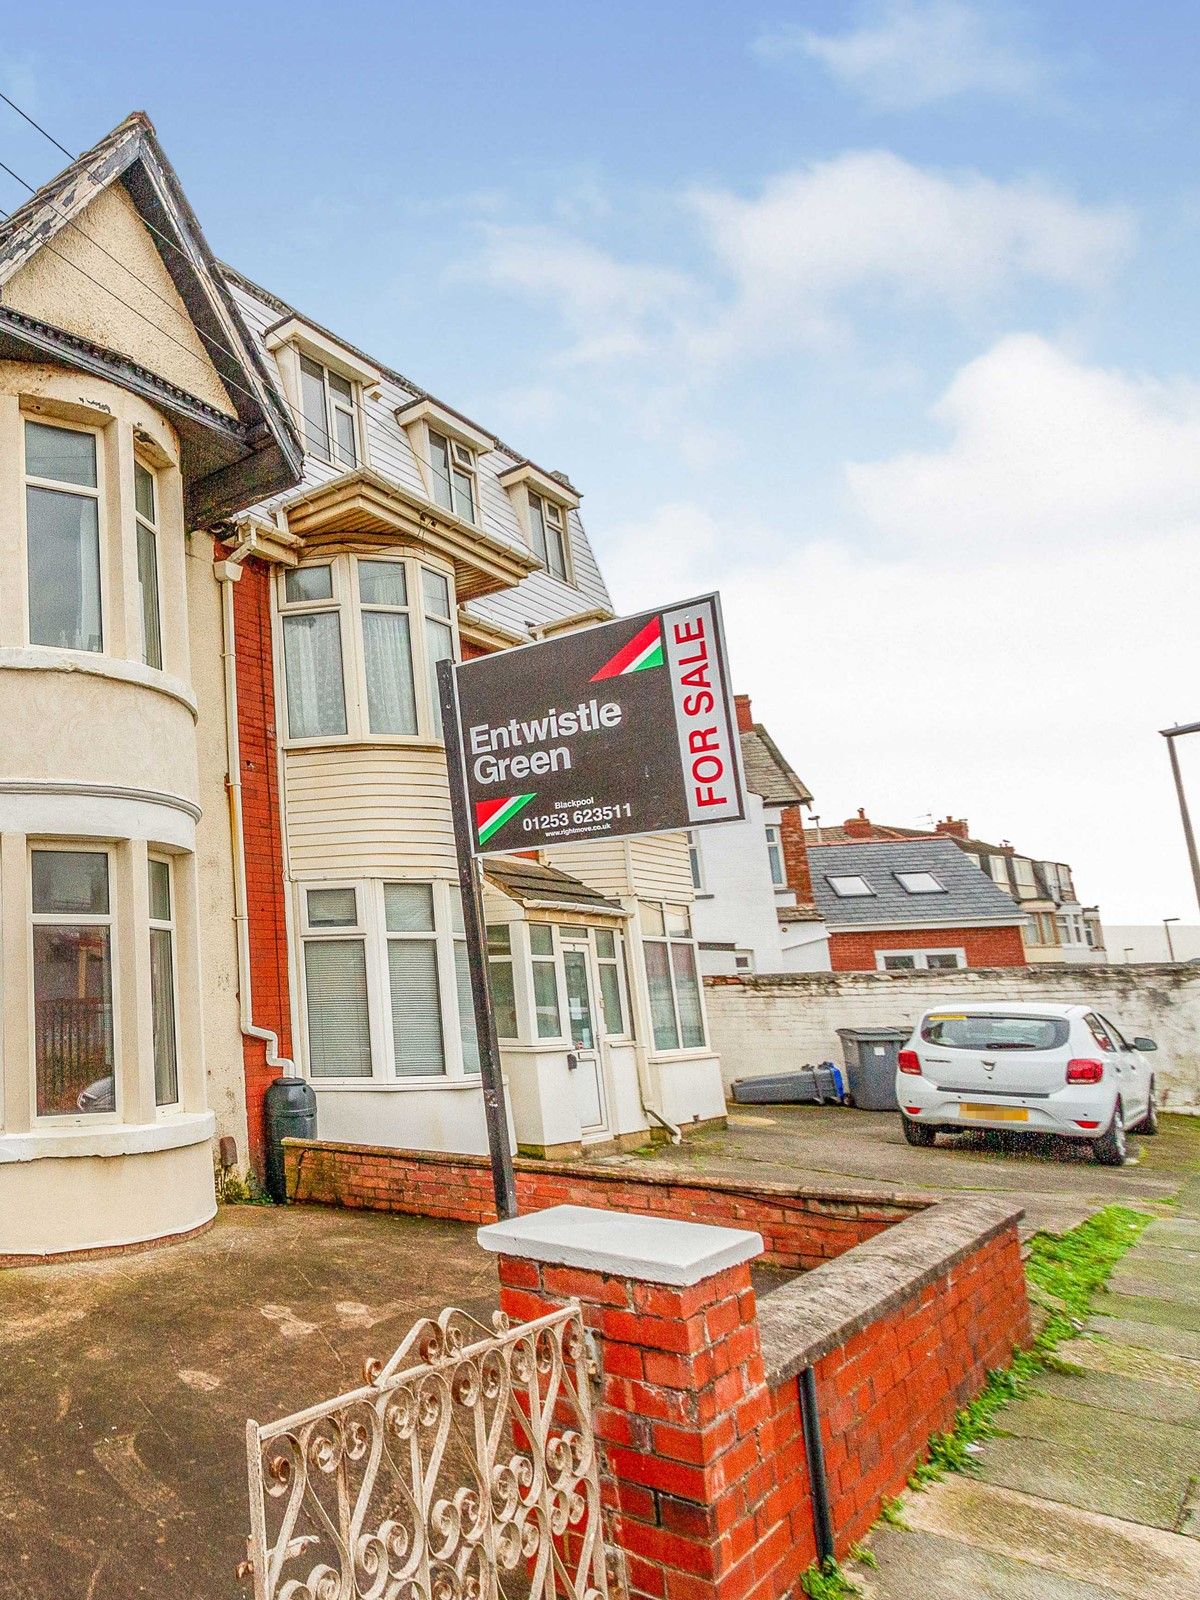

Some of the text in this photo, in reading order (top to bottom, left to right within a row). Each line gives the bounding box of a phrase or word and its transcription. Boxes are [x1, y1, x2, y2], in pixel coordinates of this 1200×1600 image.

[469, 699, 622, 755] Entwistle
[673, 617, 727, 807] FOR SALE
[473, 746, 572, 785] Green
[522, 802, 632, 831] 01253 623511
[554, 796, 595, 810] Blackpool
[545, 822, 611, 837] www.rightmove.co.uk
